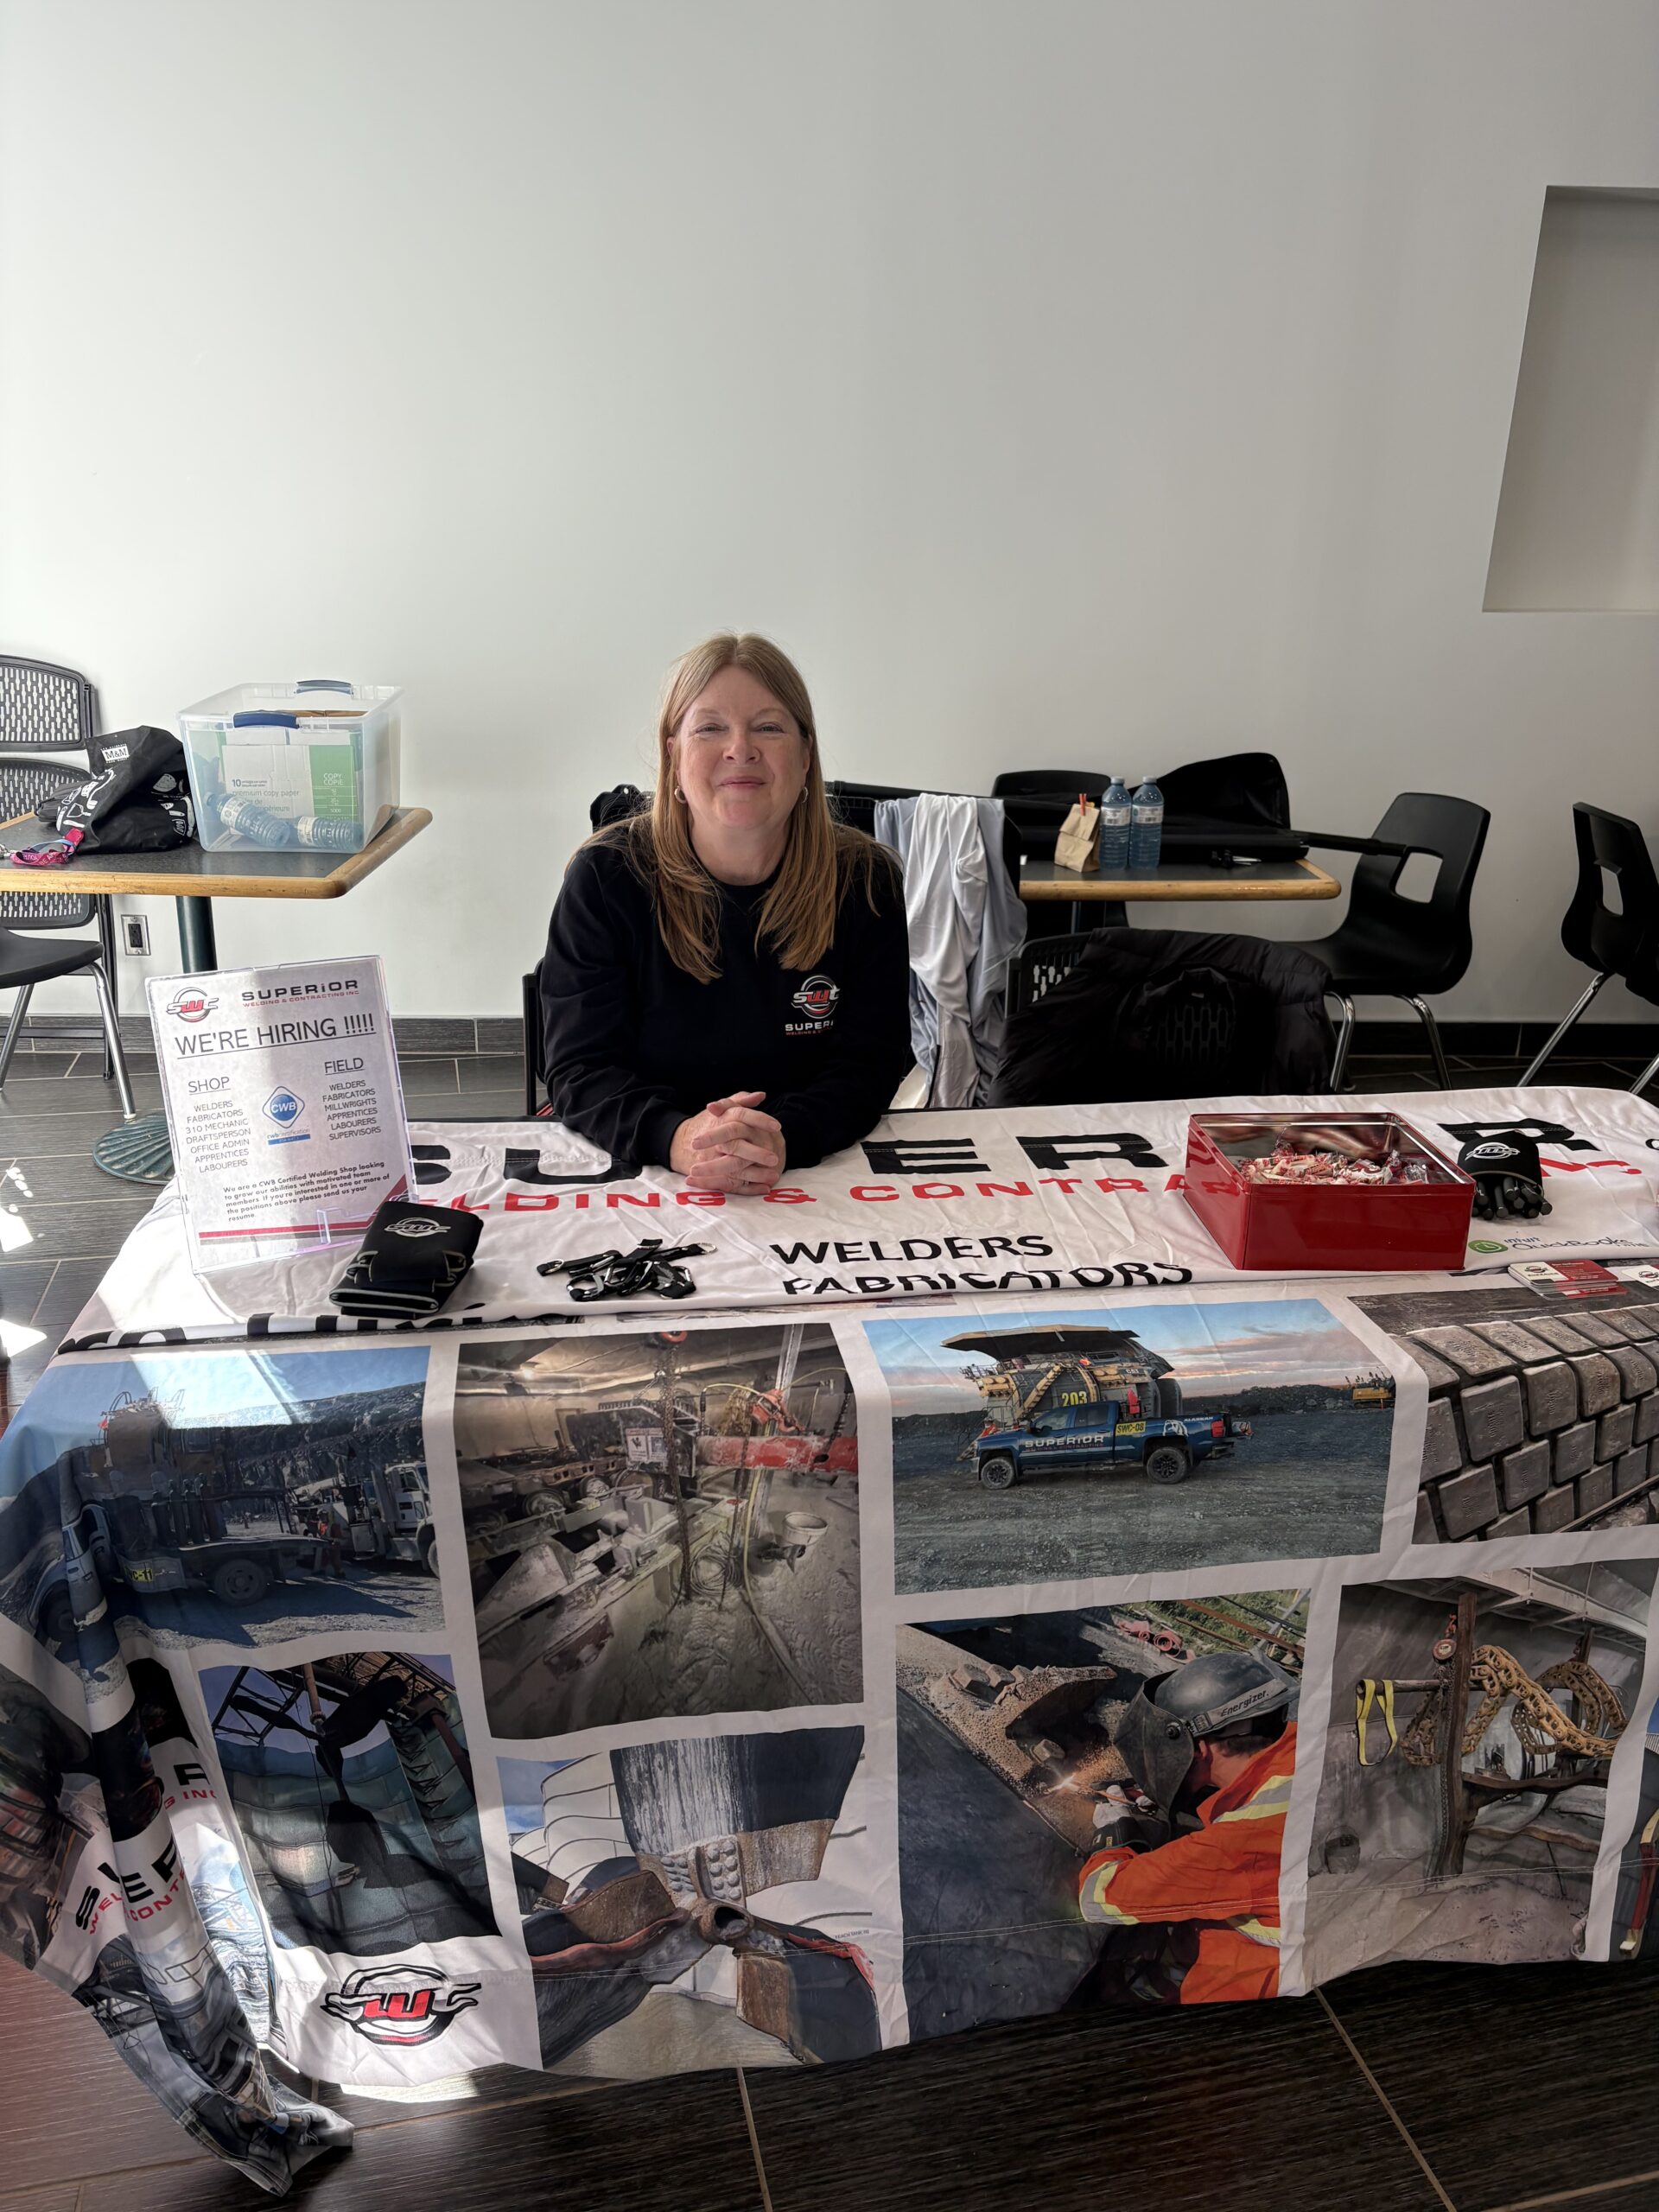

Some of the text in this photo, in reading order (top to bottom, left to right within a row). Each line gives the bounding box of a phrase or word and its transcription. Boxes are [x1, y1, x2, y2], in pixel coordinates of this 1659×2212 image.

[243, 999, 280, 1007] WELDING
[289, 992, 345, 1002] CONTRACTING
[175, 1028, 250, 1056] WE'RE
[257, 1018, 337, 1046] HIRING
[324, 1057, 364, 1074] FIELD
[188, 1077, 230, 1093] SHOP
[329, 1080, 366, 1091] WELDERS
[322, 1088, 376, 1103] FABRICATORS
[194, 1101, 233, 1112] WELDERS
[270, 1101, 296, 1114] CWB
[324, 1098, 377, 1112] MILLWRIGHTS
[187, 1109, 244, 1124] FABRICATORS
[327, 1108, 378, 1122] APPRENTICES
[186, 1118, 249, 1134] 310 MECHANIC
[331, 1117, 377, 1131] LABOURERS
[186, 1128, 251, 1145] DRAFTSPERSON
[329, 1126, 381, 1141] SUPERVISORS
[190, 1138, 250, 1154] OFFICE ADMIN
[194, 1148, 249, 1163] APPRENTICES
[199, 1159, 248, 1173] LABOURERS
[259, 1179, 276, 1187] CWB
[277, 1174, 306, 1184] Certified
[308, 1169, 338, 1179] Welding
[359, 1161, 385, 1170] looking
[233, 1191, 253, 1200] grow
[270, 1183, 297, 1192] abilities
[316, 1173, 352, 1185] motivated
[295, 1184, 328, 1195] interested
[240, 1202, 272, 1213] positions
[274, 1198, 297, 1206] above
[299, 1192, 321, 1204] please
[323, 1189, 340, 1198] send
[351, 1185, 367, 1195] your
[769, 1235, 1054, 1265] WELDERS
[782, 1261, 1193, 1296] FABRICATORS
[1061, 1390, 1088, 1408] 203
[1116, 1422, 1144, 1434] SWC-08
